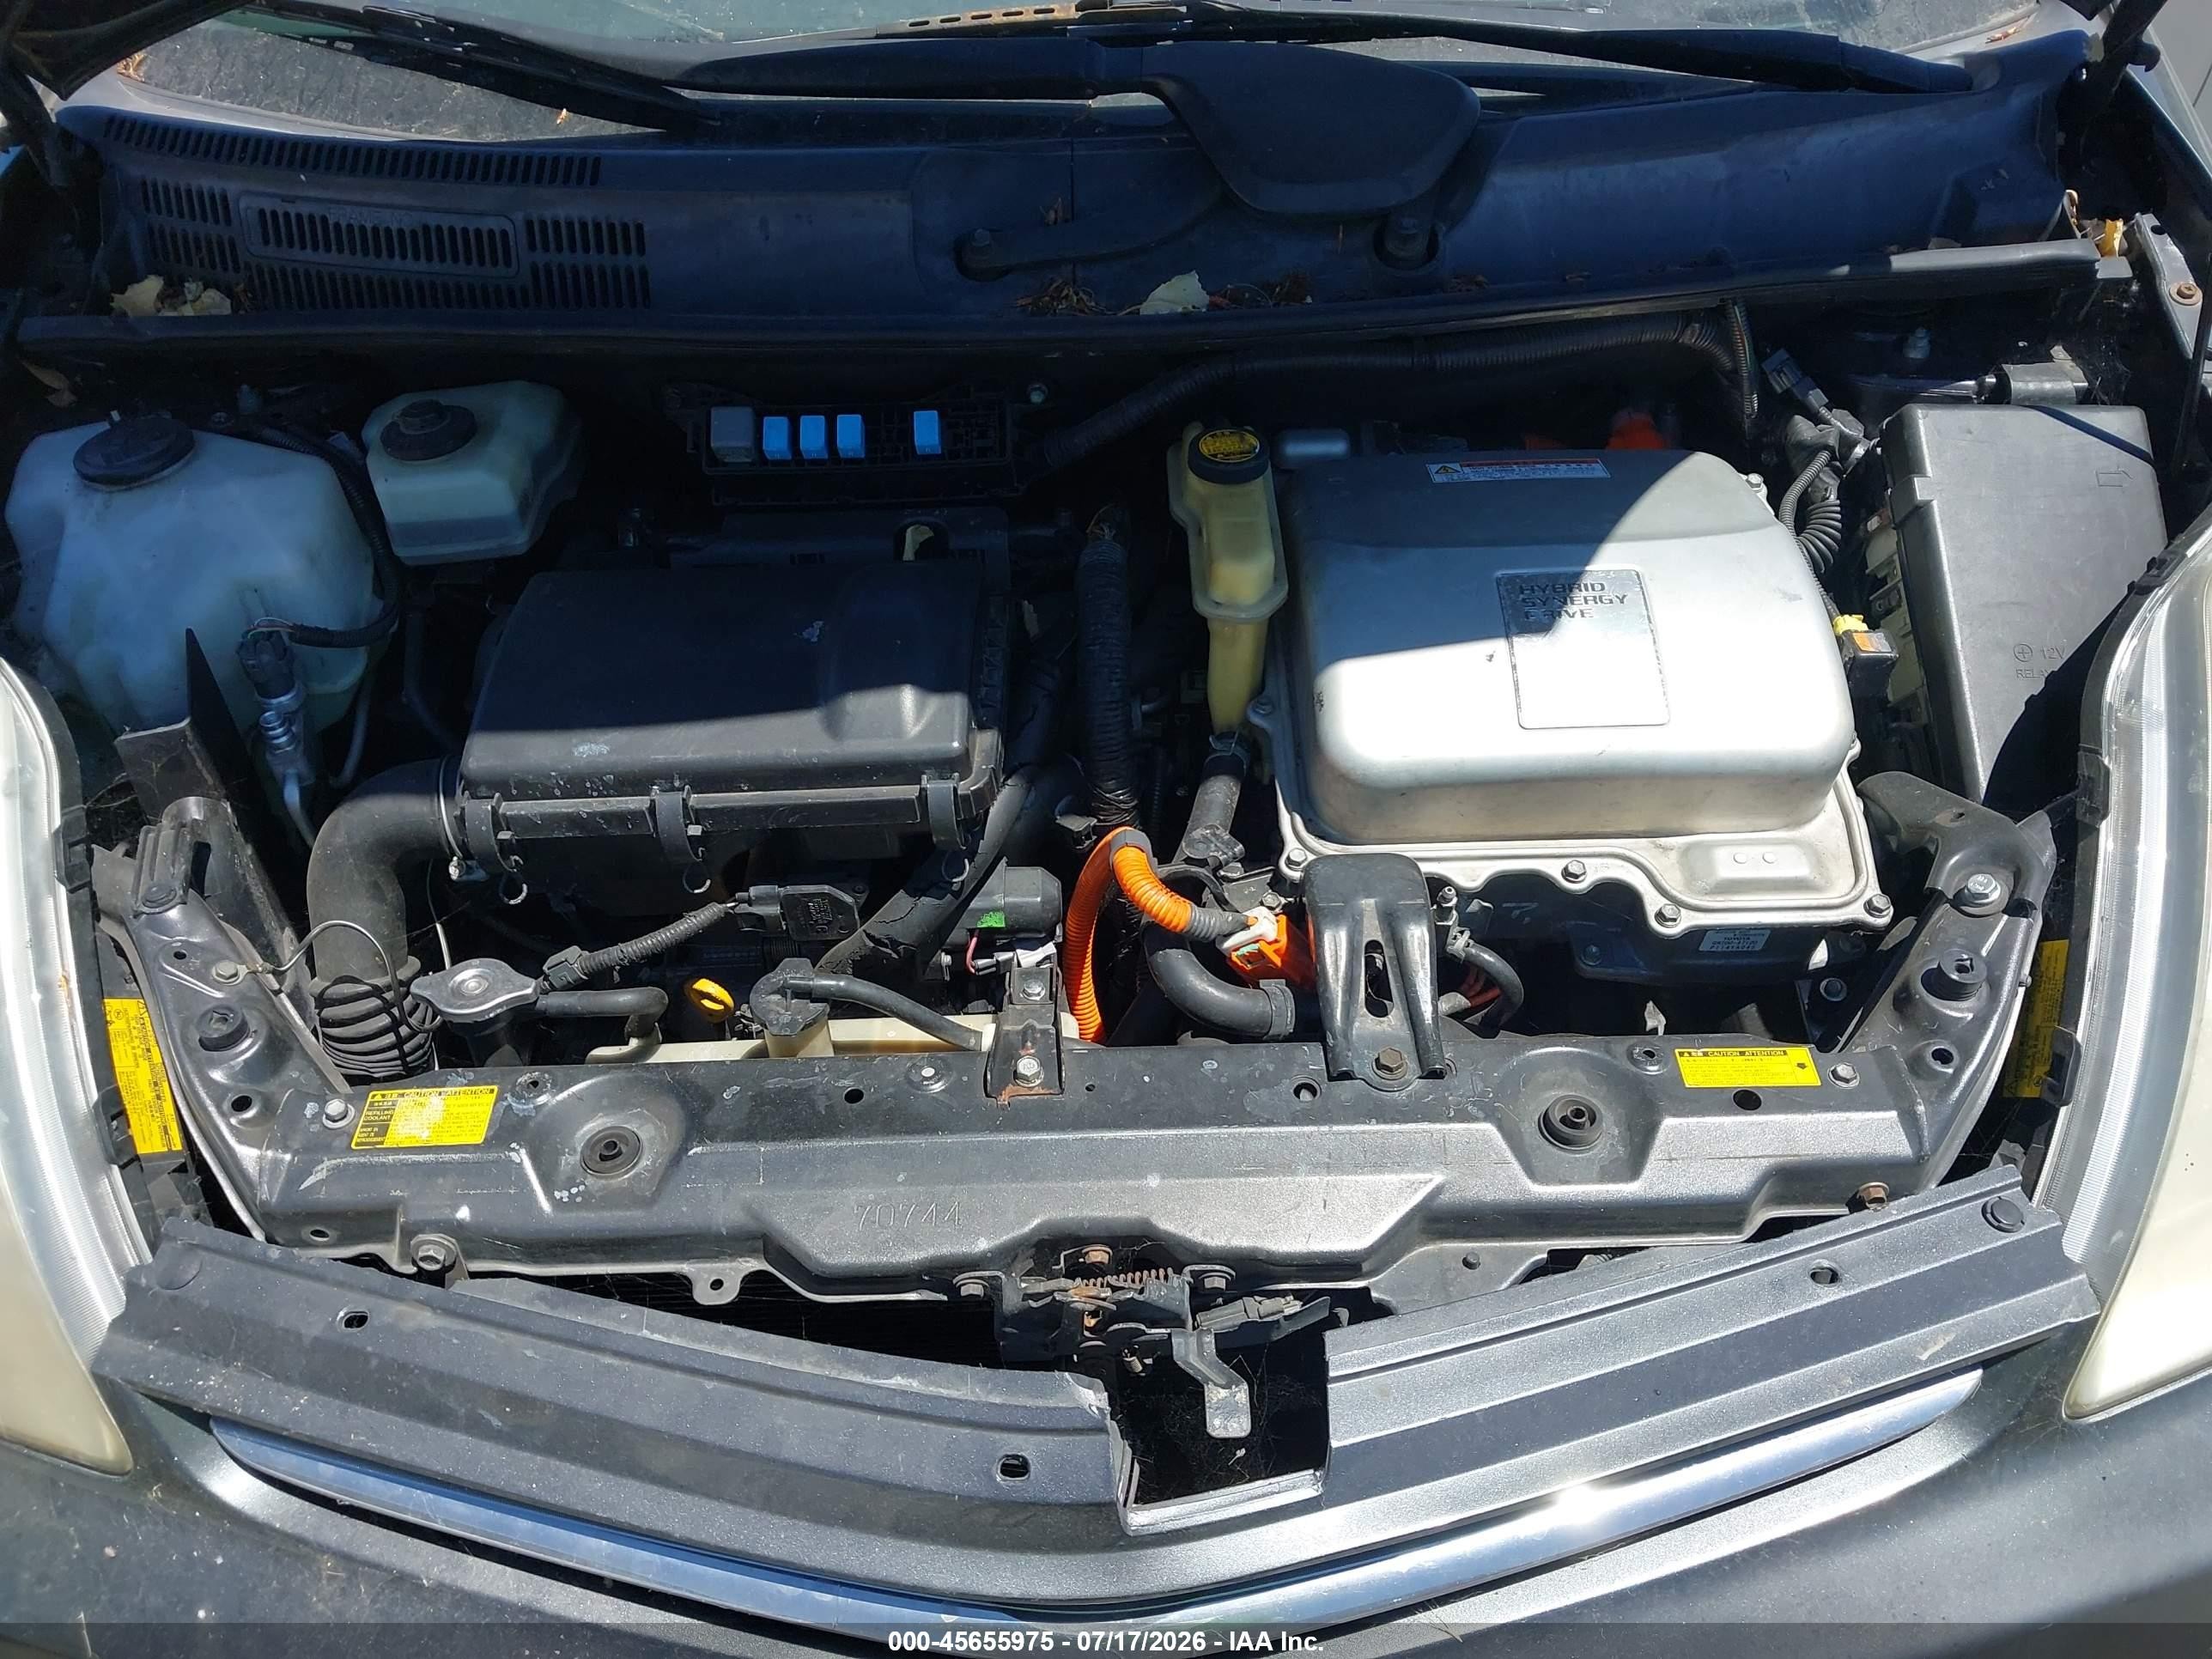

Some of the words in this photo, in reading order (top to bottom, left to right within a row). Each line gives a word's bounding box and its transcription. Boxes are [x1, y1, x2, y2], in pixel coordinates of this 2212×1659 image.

[1520, 582, 1606, 594] HYBRID
[1522, 594, 1628, 606] SYNERGY
[447, 1088, 489, 1097] ATTENTION
[854, 1200, 962, 1231] 70744
